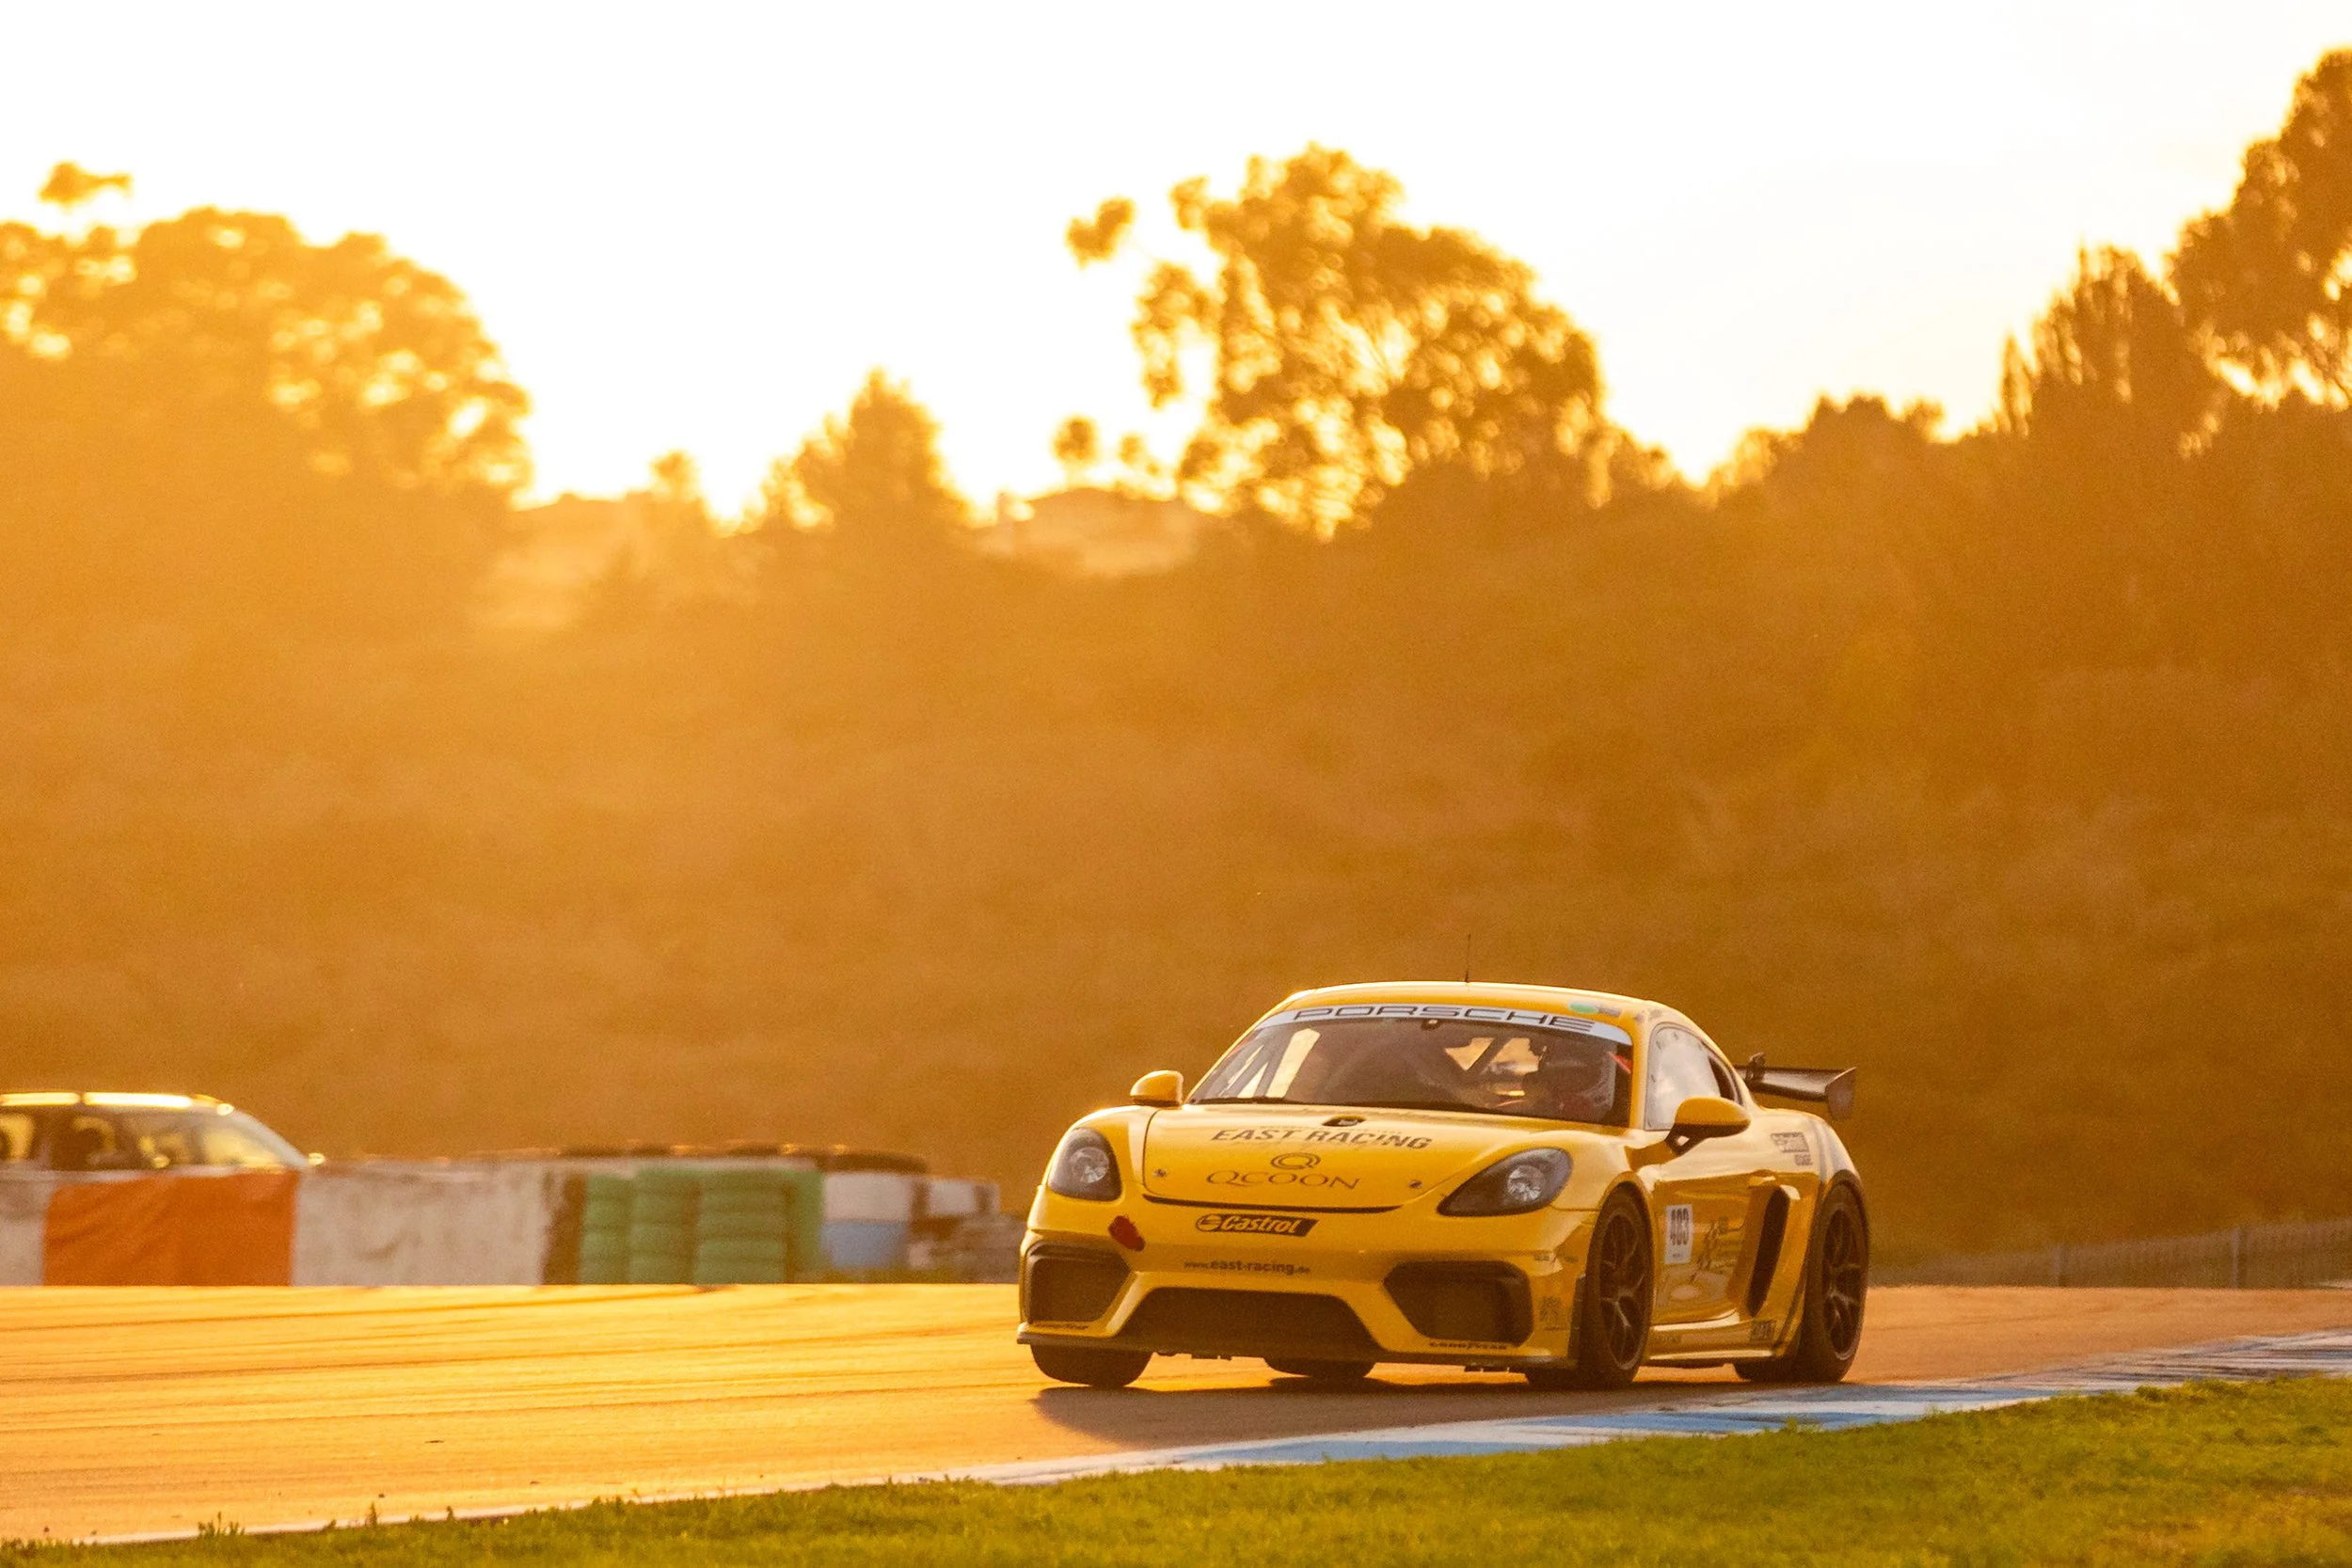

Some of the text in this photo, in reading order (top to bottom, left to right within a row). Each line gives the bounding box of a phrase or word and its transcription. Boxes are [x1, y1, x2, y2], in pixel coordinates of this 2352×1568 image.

[1294, 1003, 1597, 1033] PORSCHE
[1210, 1129, 1433, 1149] EAST RACING
[1206, 1170, 1361, 1190] QCOON
[1221, 1214, 1304, 1235] Castrol
[1184, 1259, 1311, 1275] www.east-racing.de
